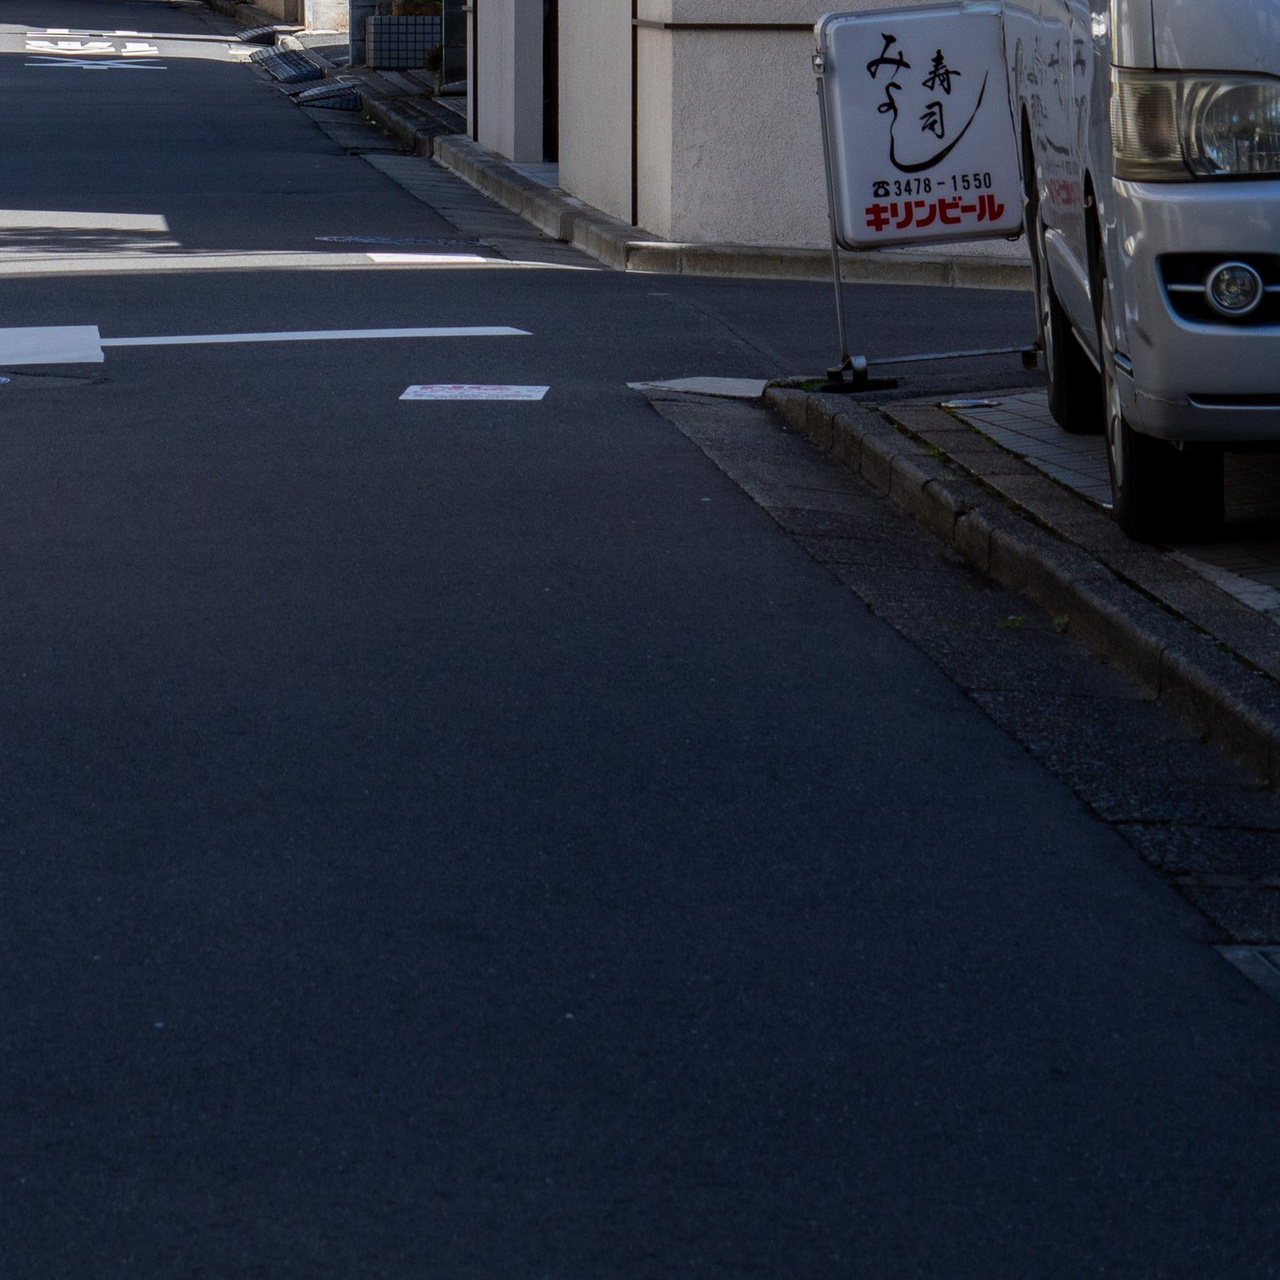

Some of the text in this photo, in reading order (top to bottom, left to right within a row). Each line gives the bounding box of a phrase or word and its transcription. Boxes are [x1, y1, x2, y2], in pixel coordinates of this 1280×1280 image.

[919, 49, 962, 140] 寿司
[864, 193, 1005, 232] キリンビール
